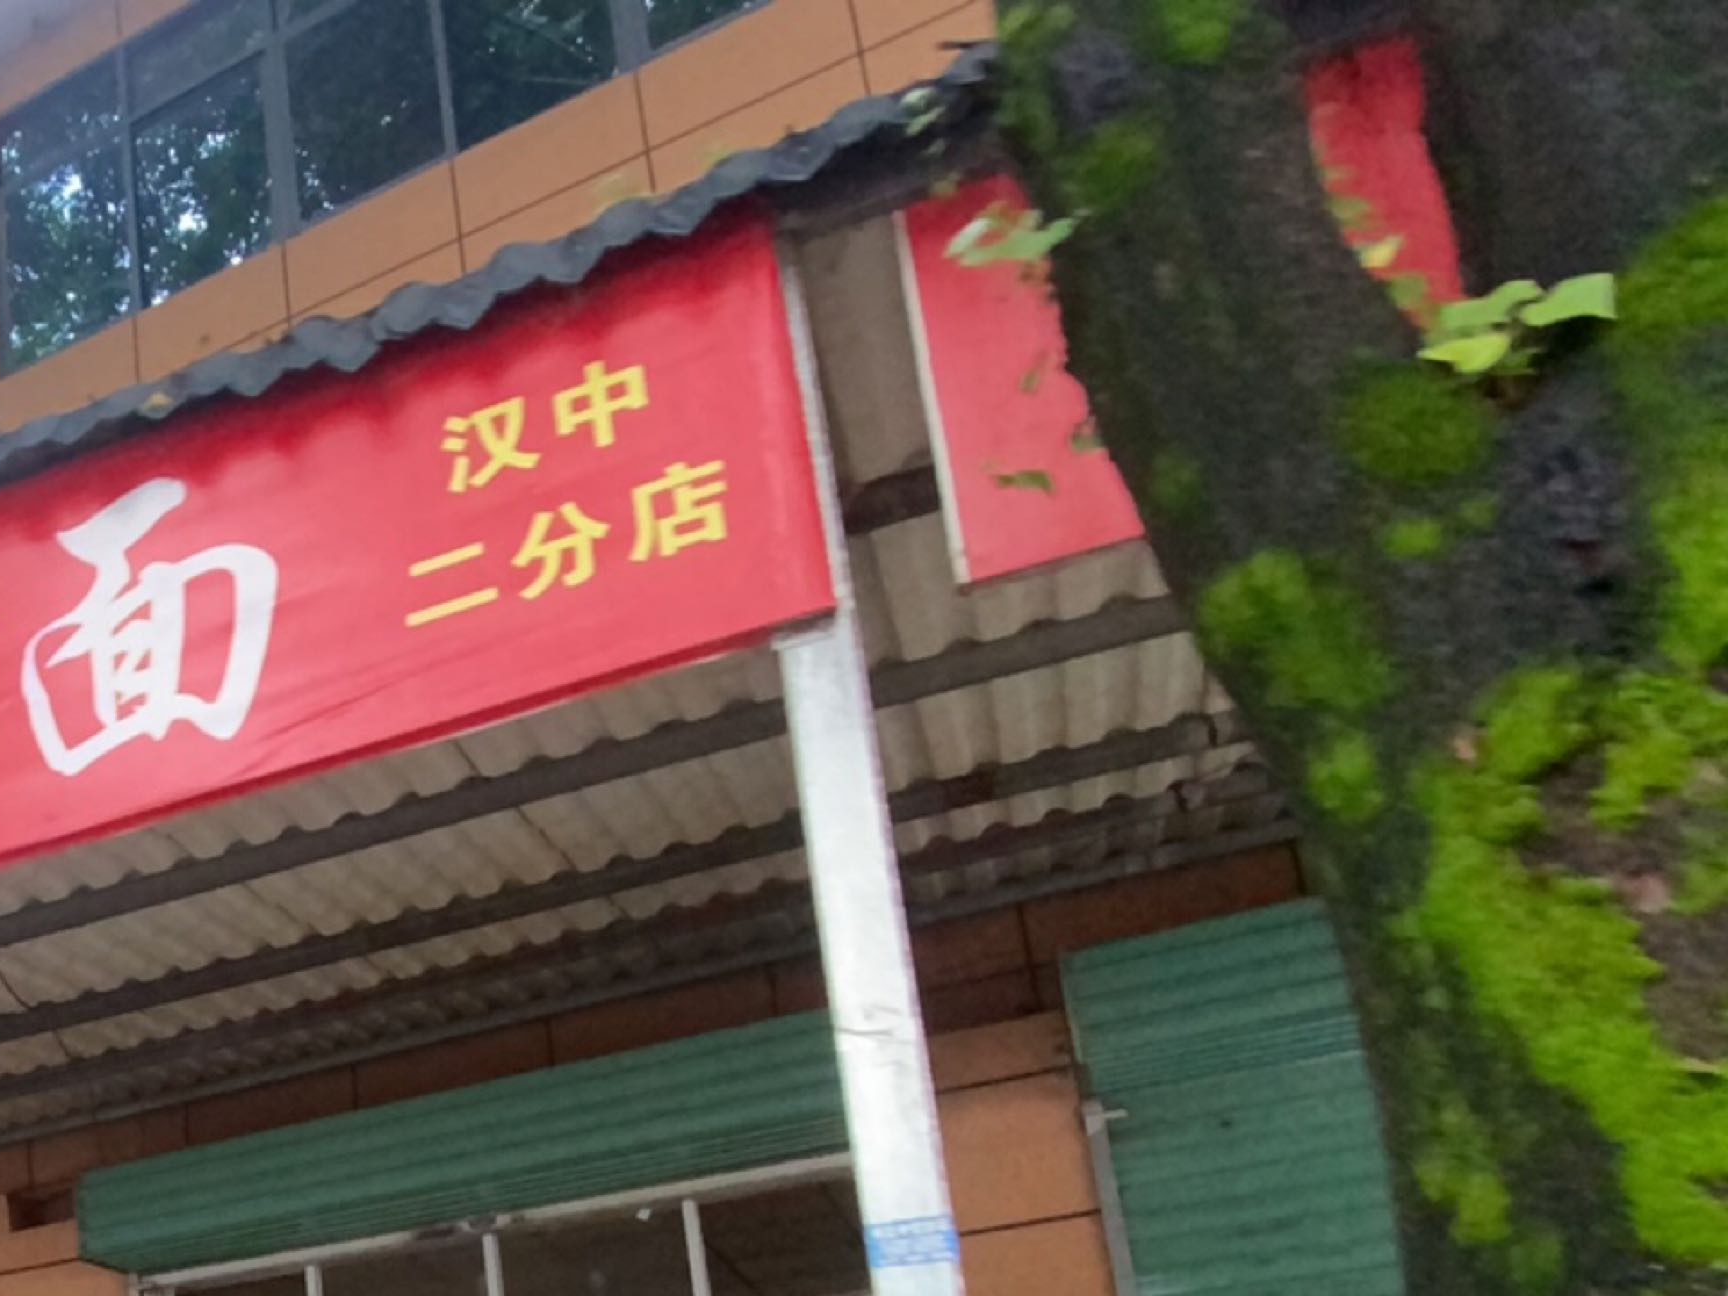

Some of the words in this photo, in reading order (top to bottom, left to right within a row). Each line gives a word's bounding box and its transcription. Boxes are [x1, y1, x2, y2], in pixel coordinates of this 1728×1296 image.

[439, 360, 650, 493] 汉中
[404, 460, 728, 627] 二分店
